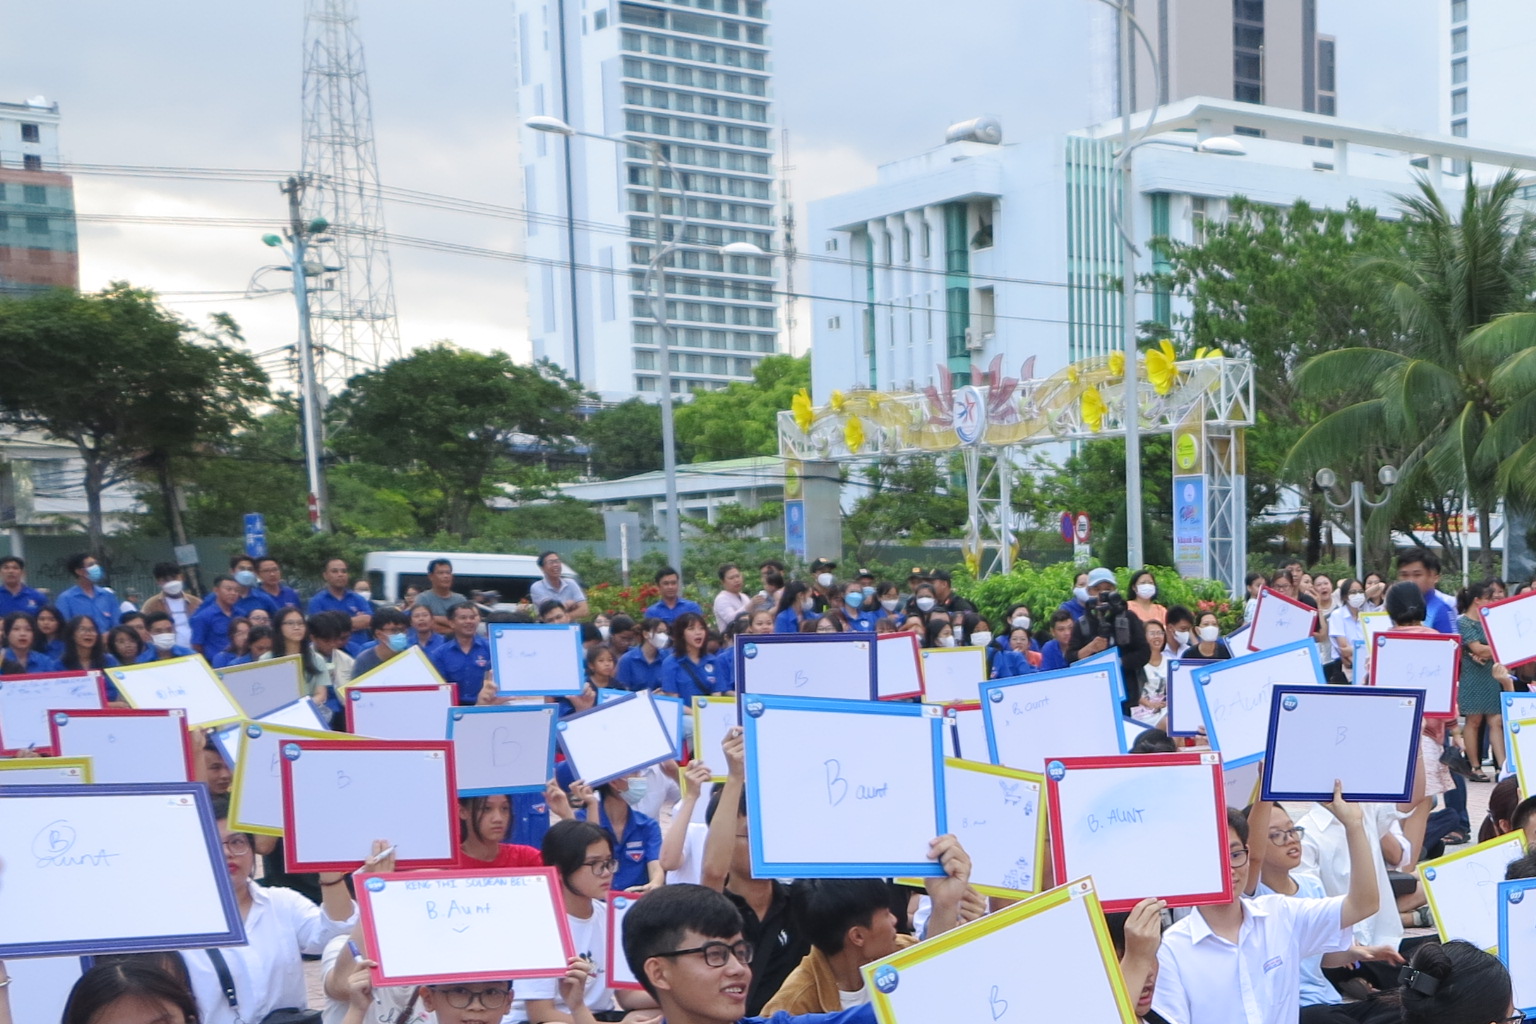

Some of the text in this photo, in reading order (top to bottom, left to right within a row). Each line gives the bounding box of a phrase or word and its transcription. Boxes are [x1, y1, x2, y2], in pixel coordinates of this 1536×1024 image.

[794, 669, 809, 688] B
[1335, 726, 1348, 746] B
[491, 726, 521, 767] B
[824, 759, 888, 807] B aunt
[1107, 808, 1146, 825] AUNT
[49, 829, 70, 850] B
[876, 973, 896, 985] 019
[988, 984, 1008, 1022] B
